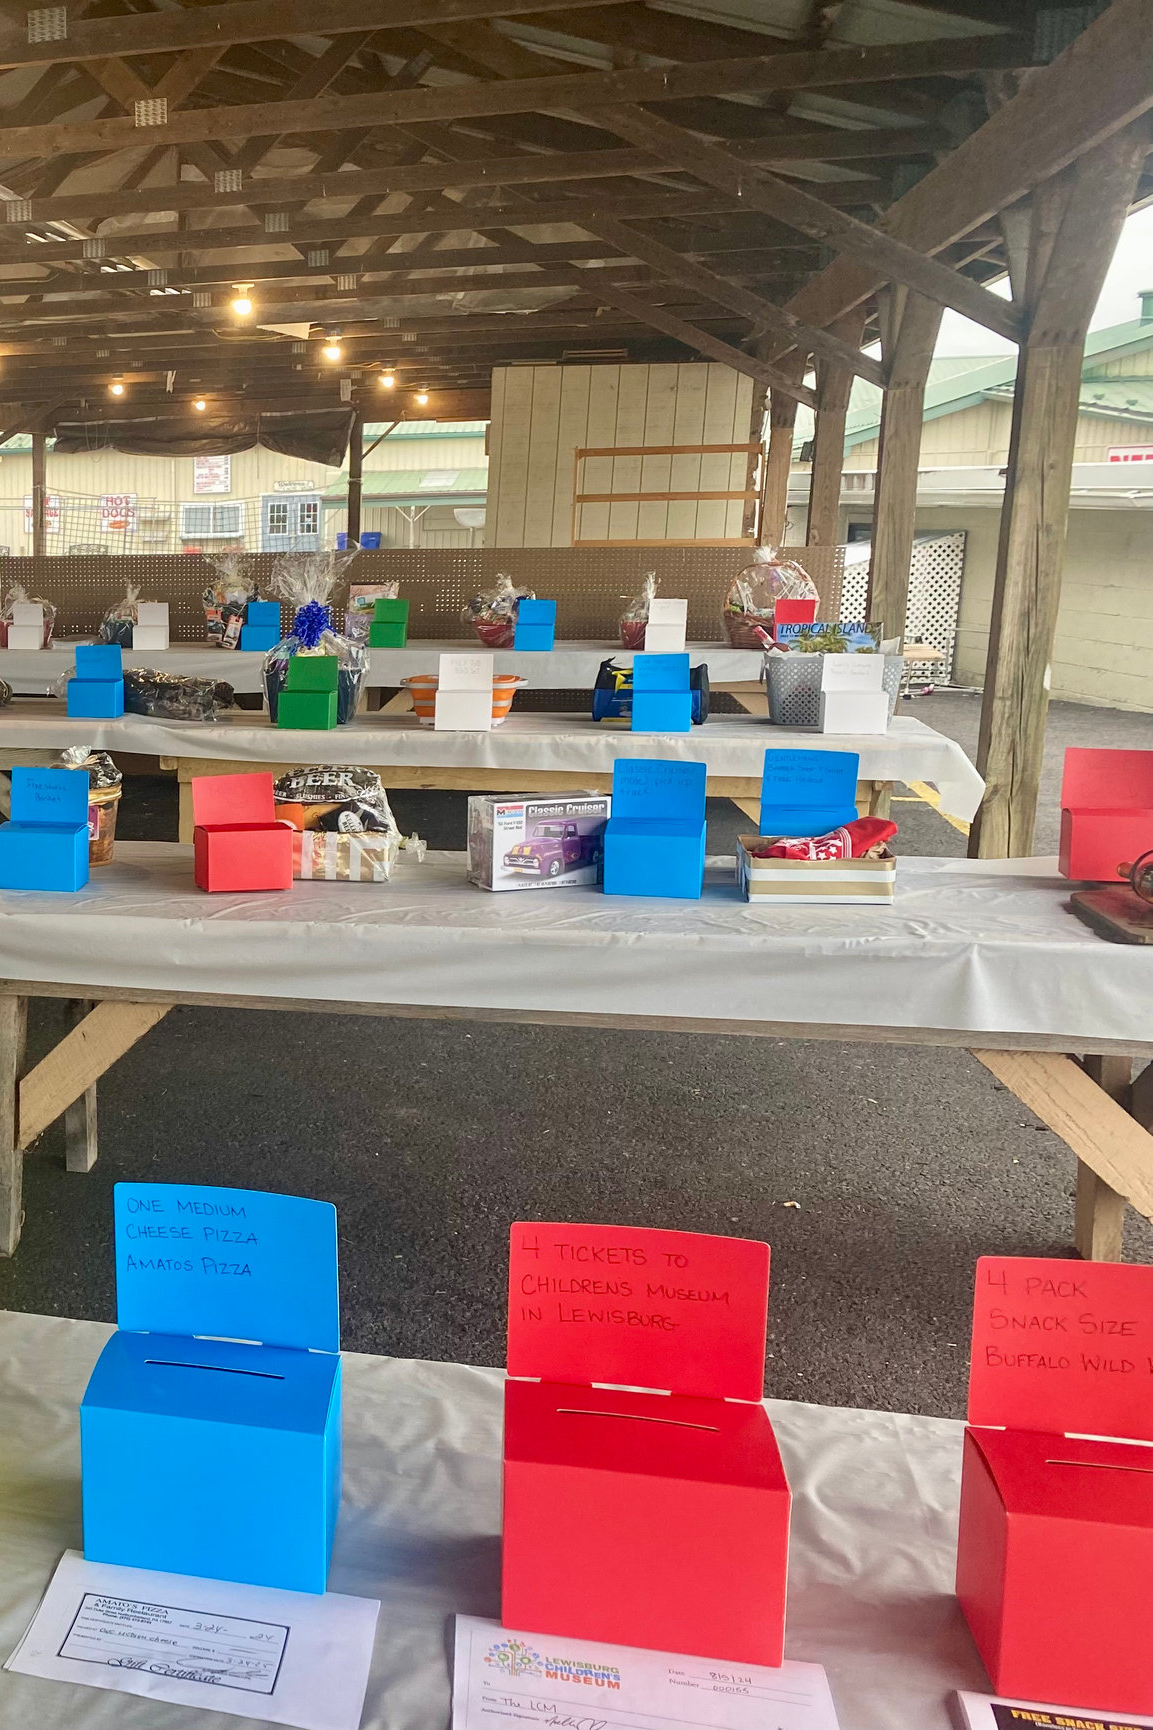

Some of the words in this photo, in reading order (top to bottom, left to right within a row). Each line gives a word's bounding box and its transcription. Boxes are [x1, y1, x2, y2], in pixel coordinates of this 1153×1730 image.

[105, 496, 130, 506] HOT
[780, 623, 832, 634] TROPICAL
[289, 772, 356, 789] BEER
[274, 790, 287, 798] EER
[528, 805, 564, 817] Classic
[567, 803, 605, 815] Cruiser
[127, 1198, 165, 1213] ONE
[177, 1200, 247, 1219] MEDIUM
[126, 1223, 193, 1240] CHEESE
[203, 1226, 258, 1246] PIZZA
[521, 1235, 540, 1259] 4
[554, 1243, 647, 1266] TICKETS
[662, 1253, 689, 1269] TO
[201, 1256, 252, 1277] PIZZA
[987, 1269, 1008, 1295] 4
[1026, 1277, 1088, 1299] PACK
[647, 1284, 730, 1306] MUSEUM
[522, 1307, 542, 1321] IN
[558, 1302, 680, 1332] LEWISBURG
[989, 1308, 1068, 1333] SNACK
[1078, 1312, 1140, 1336] SIZE
[985, 1345, 1071, 1369] BUFFALO
[1081, 1352, 1136, 1374] WILD
[95, 1598, 138, 1610] AMATO'S
[142, 1605, 170, 1615] PIZZA
[100, 1603, 126, 1613] Family
[545, 1662, 621, 1682] CHILDREN'S
[546, 1656, 620, 1675] LEWISBURG
[668, 1668, 685, 1677] Date
[545, 1670, 621, 1690] MUSEUM
[669, 1678, 699, 1689] Number
[1011, 1709, 1052, 1724] FREE
[1054, 1716, 1106, 1730] SNACK
